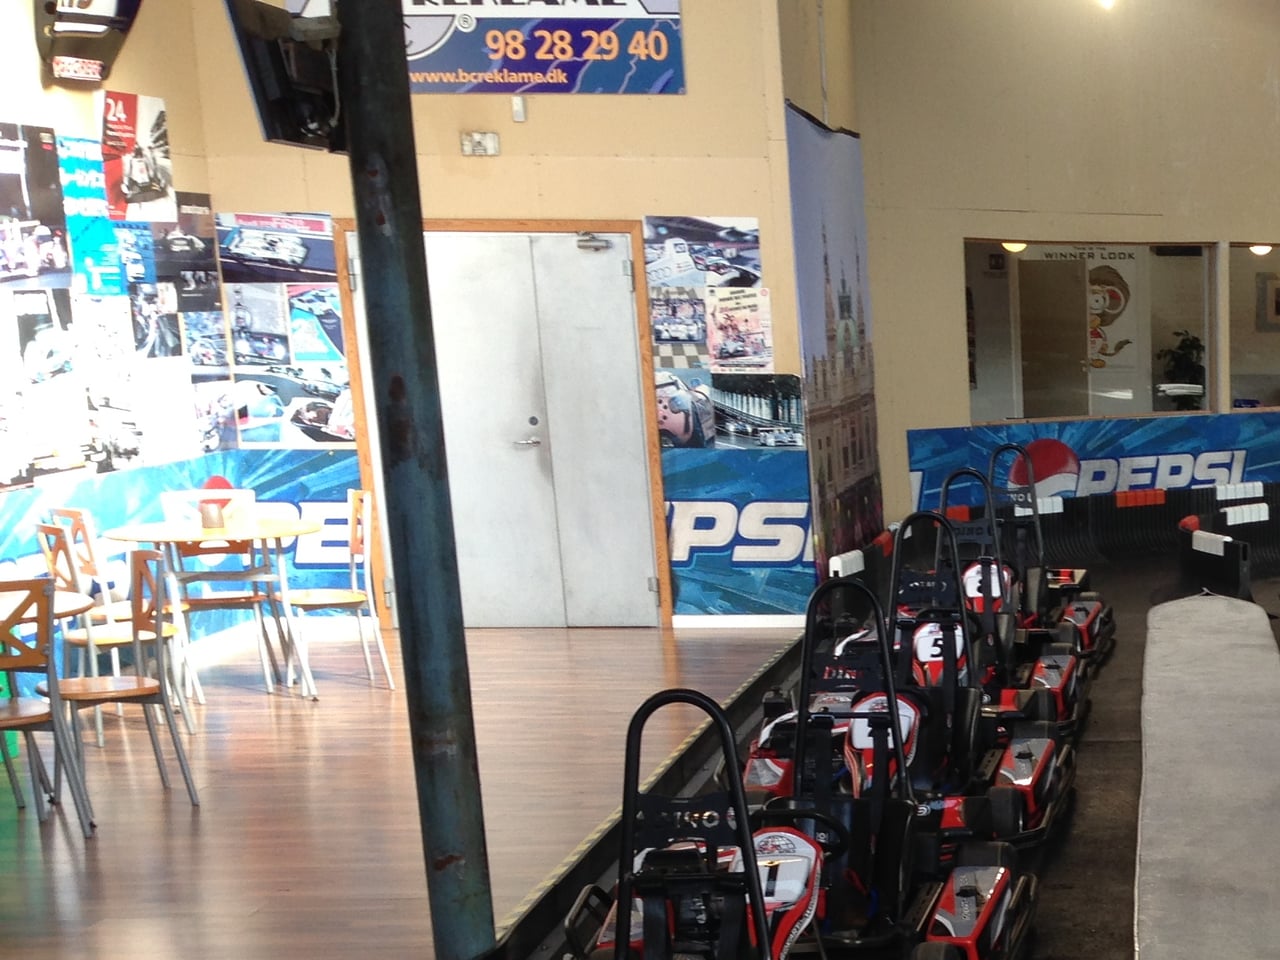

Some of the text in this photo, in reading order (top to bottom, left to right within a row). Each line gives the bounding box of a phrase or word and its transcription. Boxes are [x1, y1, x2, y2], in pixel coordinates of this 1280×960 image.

[485, 30, 668, 60] 98 28 29 40
[409, 68, 568, 84] www.bcreklame.dk
[105, 98, 127, 123] 24
[1044, 252, 1136, 260] WINNER LOOK
[1077, 450, 1248, 497] PEPSI
[930, 638, 944, 657] 5
[765, 862, 780, 897] 1
